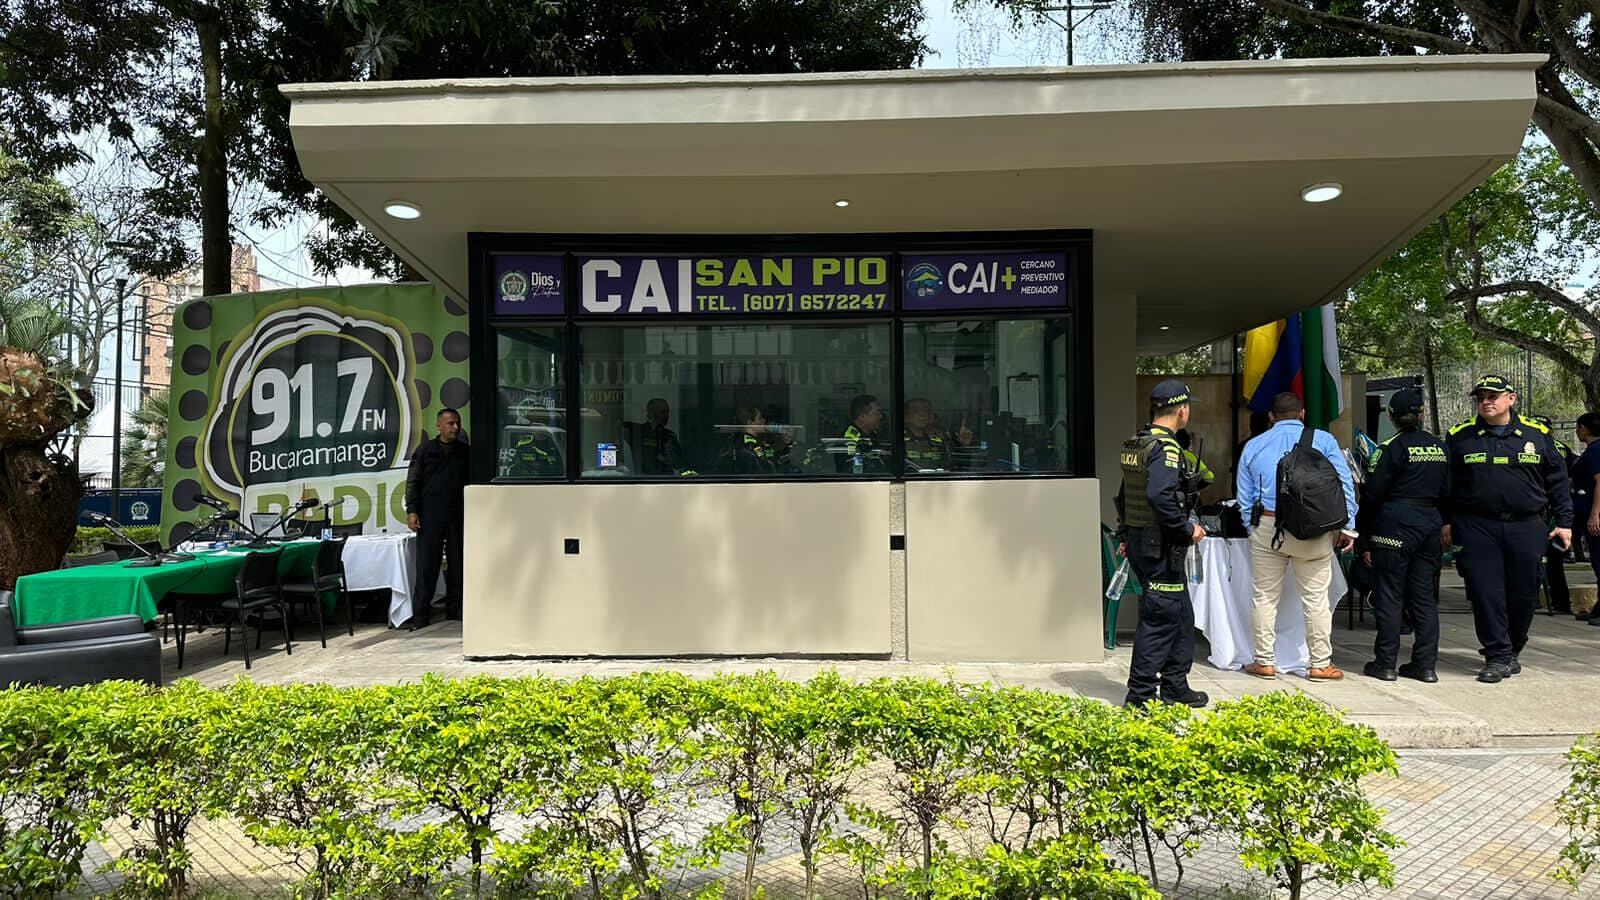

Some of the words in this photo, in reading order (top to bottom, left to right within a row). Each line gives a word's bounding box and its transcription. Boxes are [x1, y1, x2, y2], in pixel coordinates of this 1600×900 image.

[695, 258, 793, 286] SAN
[812, 257, 887, 286] PIO
[1020, 260, 1056, 269] CERCANO
[531, 272, 554, 287] Dios
[582, 259, 692, 312] CAI
[1020, 272, 1065, 281] PREVENTIVO
[1020, 285, 1058, 294] MEDIADOR
[696, 295, 736, 311] TEL.
[800, 293, 886, 310] 6572247
[251, 357, 373, 446] 91.7
[362, 408, 386, 431] FM
[250, 441, 387, 473] Bucaramanga
